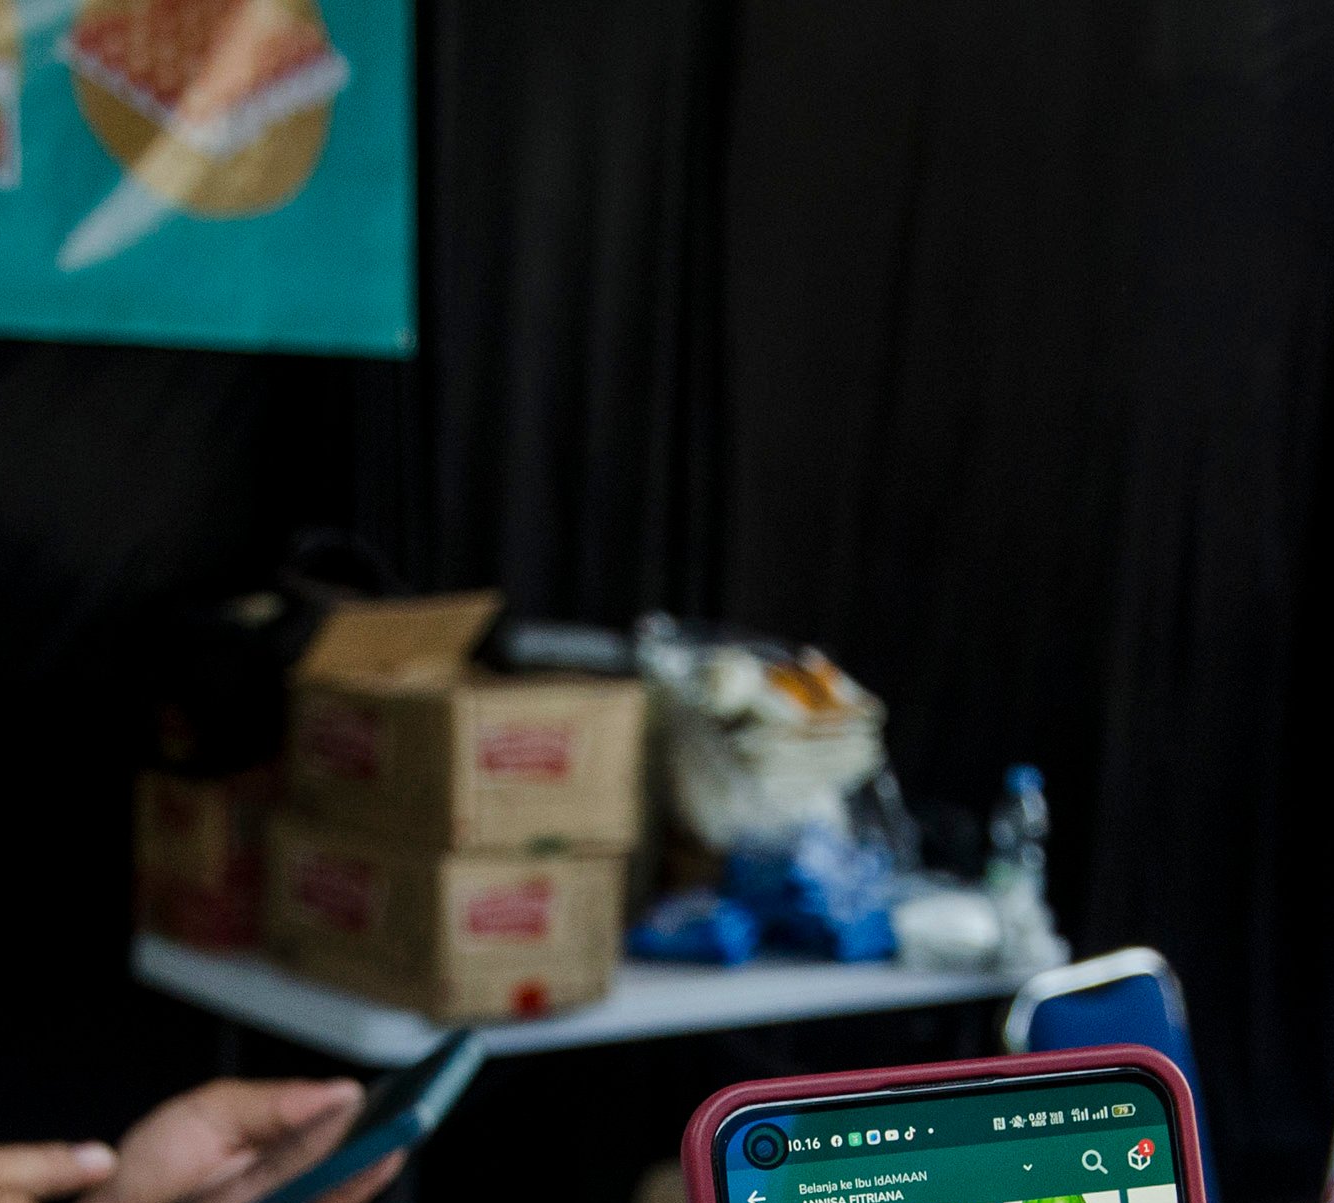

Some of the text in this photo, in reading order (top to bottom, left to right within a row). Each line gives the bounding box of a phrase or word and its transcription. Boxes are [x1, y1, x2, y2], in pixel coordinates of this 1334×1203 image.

[1143, 1143, 1150, 1154] 1
[799, 1180, 838, 1195] Belanja
[840, 1178, 853, 1190] ke
[855, 1175, 872, 1189] Ibu
